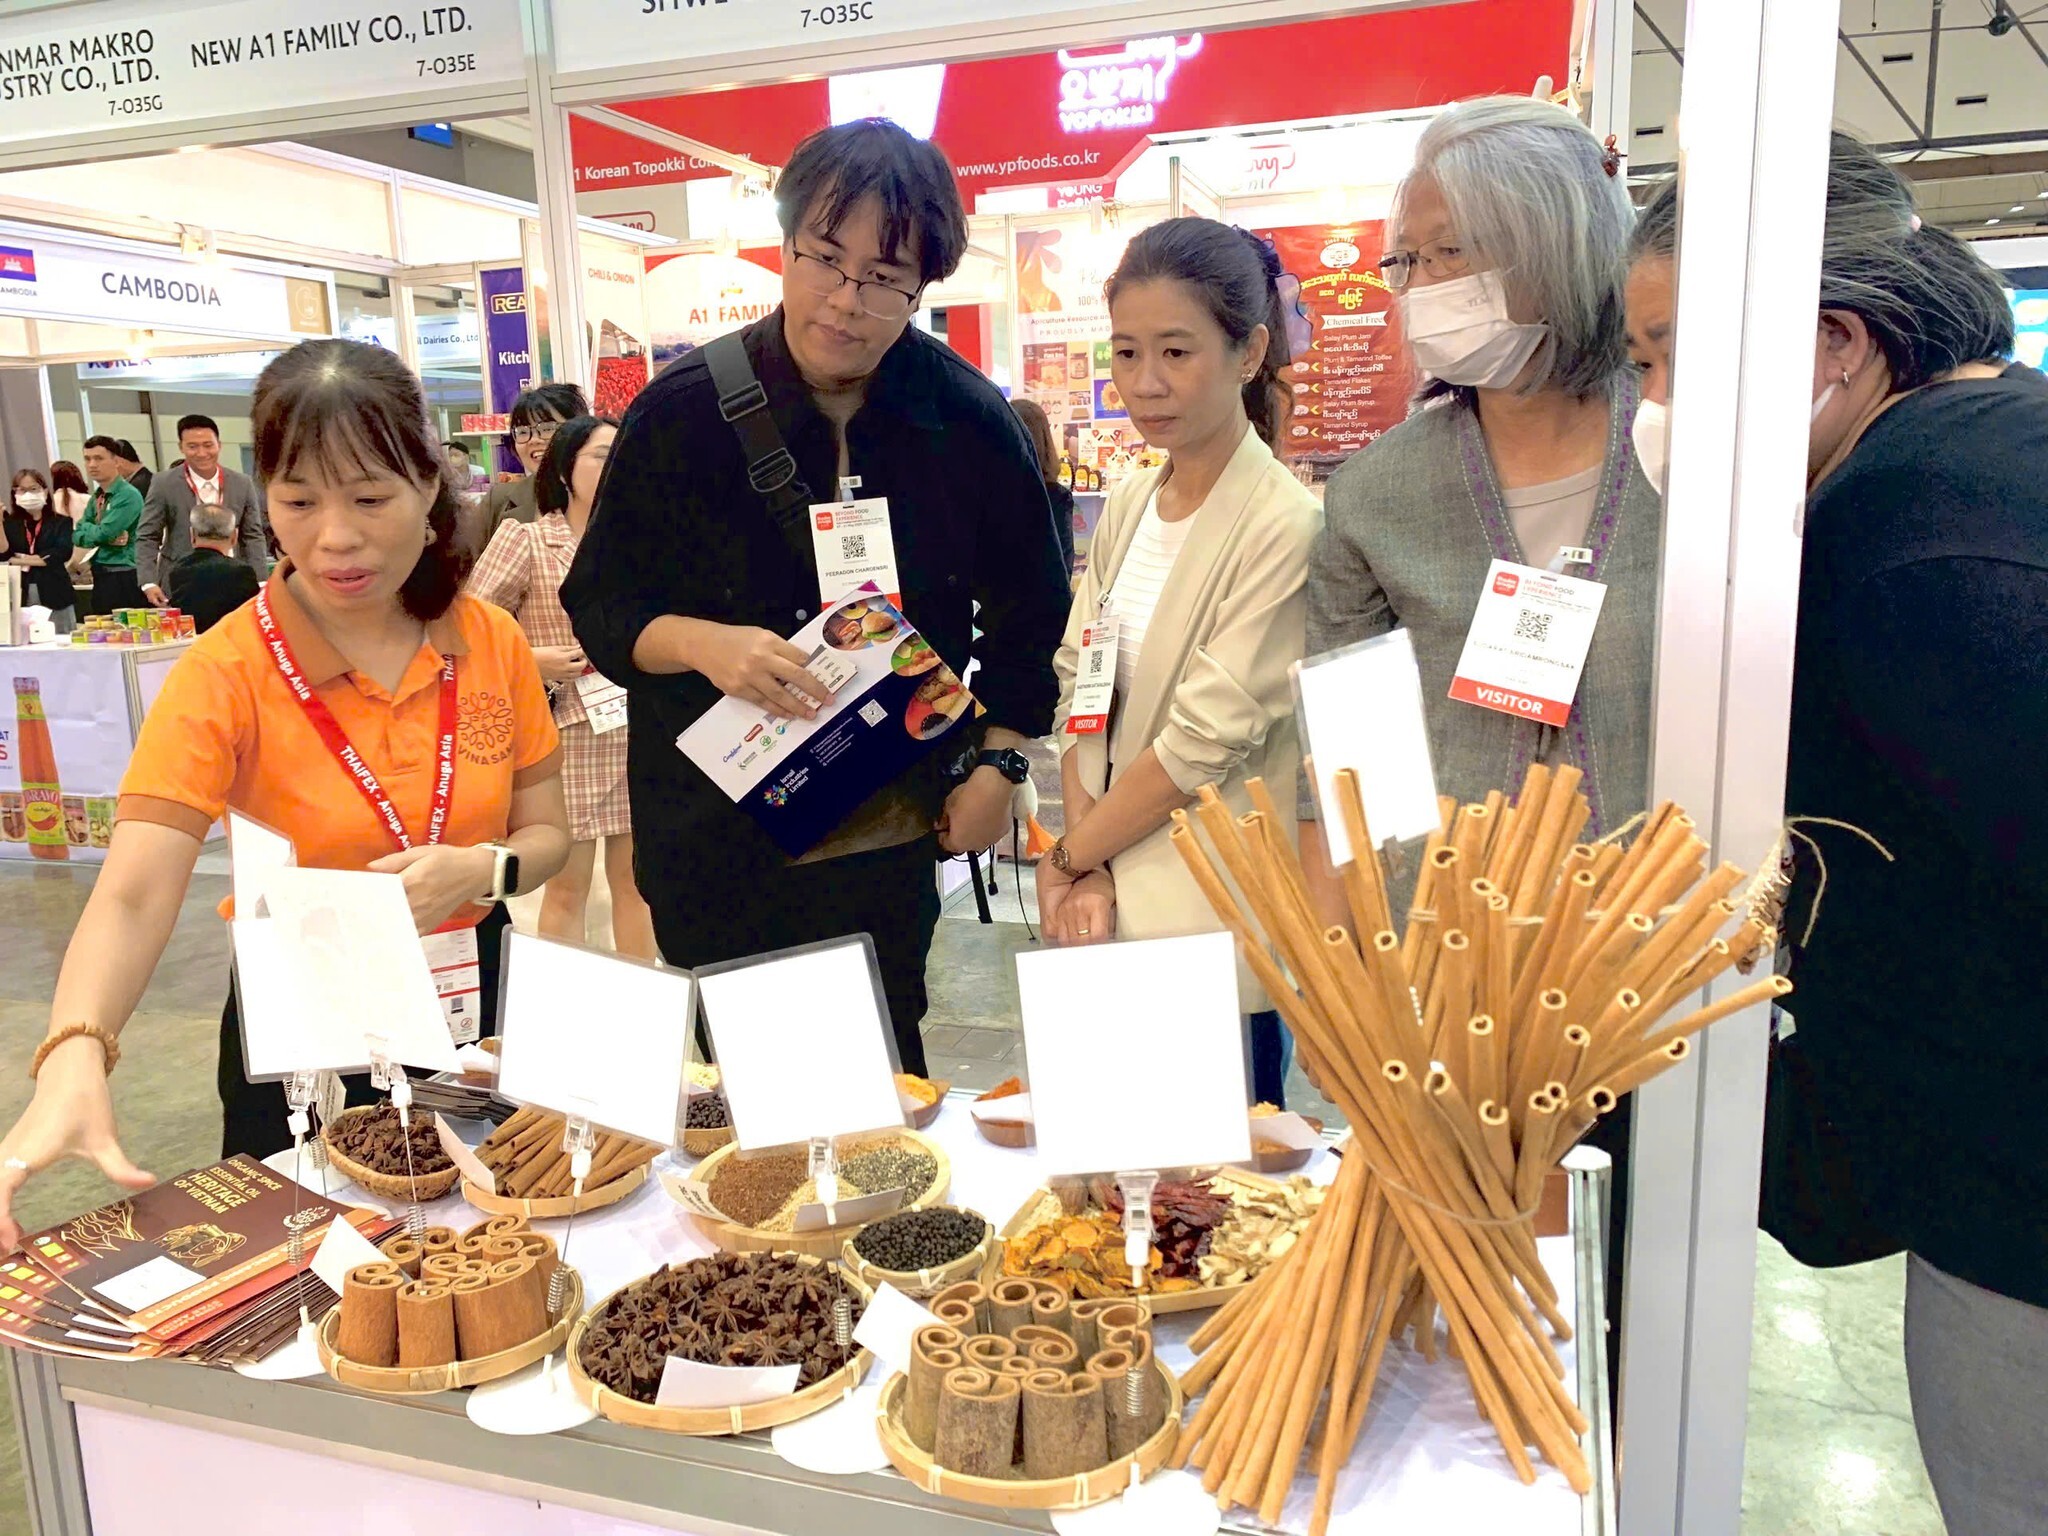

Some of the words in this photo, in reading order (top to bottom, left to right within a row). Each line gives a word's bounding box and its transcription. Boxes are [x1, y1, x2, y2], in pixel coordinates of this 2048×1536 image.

[69, 29, 154, 64] MAKRO
[191, 37, 242, 68] NEW
[249, 33, 275, 60] A1
[284, 20, 361, 55] FAMILY
[368, 15, 416, 44] CO.,
[422, 6, 473, 37] LTD.
[0, 70, 53, 101] STRY
[61, 66, 107, 93] CO.,
[112, 58, 160, 86] LTD.
[1058, 102, 1154, 134] YOPOKKI
[584, 165, 630, 181] Korean
[633, 156, 686, 176] Topokki
[956, 148, 1101, 178] www.ypfoods.co.kr
[1056, 184, 1103, 198] YOUNG
[101, 271, 222, 307] CAMBODIA
[612, 272, 636, 285] ONION
[689, 308, 709, 325] A1
[1326, 316, 1364, 327] Chemical
[1365, 315, 1384, 324] Free
[423, 335, 449, 345] Dairies
[1357, 399, 1376, 407] Syrup
[269, 640, 295, 676] Anuga
[289, 675, 311, 701] Asia
[1475, 686, 1544, 716] VISITOR
[1075, 718, 1098, 730] VISITOR
[438, 733, 453, 759] Asia
[340, 744, 381, 796] THAIFEX
[377, 799, 403, 835] Anuga
[436, 757, 454, 798] Anuga
[23, 789, 60, 803] BRAVO
[187, 1172, 249, 1208] HERITAGE
[209, 1166, 249, 1195] ESSENTIAL
[245, 1185, 261, 1199] OIL
[226, 1158, 259, 1184] ORGANIC
[256, 1173, 283, 1193] SPICE
[173, 1179, 188, 1192] OF
[183, 1184, 230, 1215] VIETNAM
